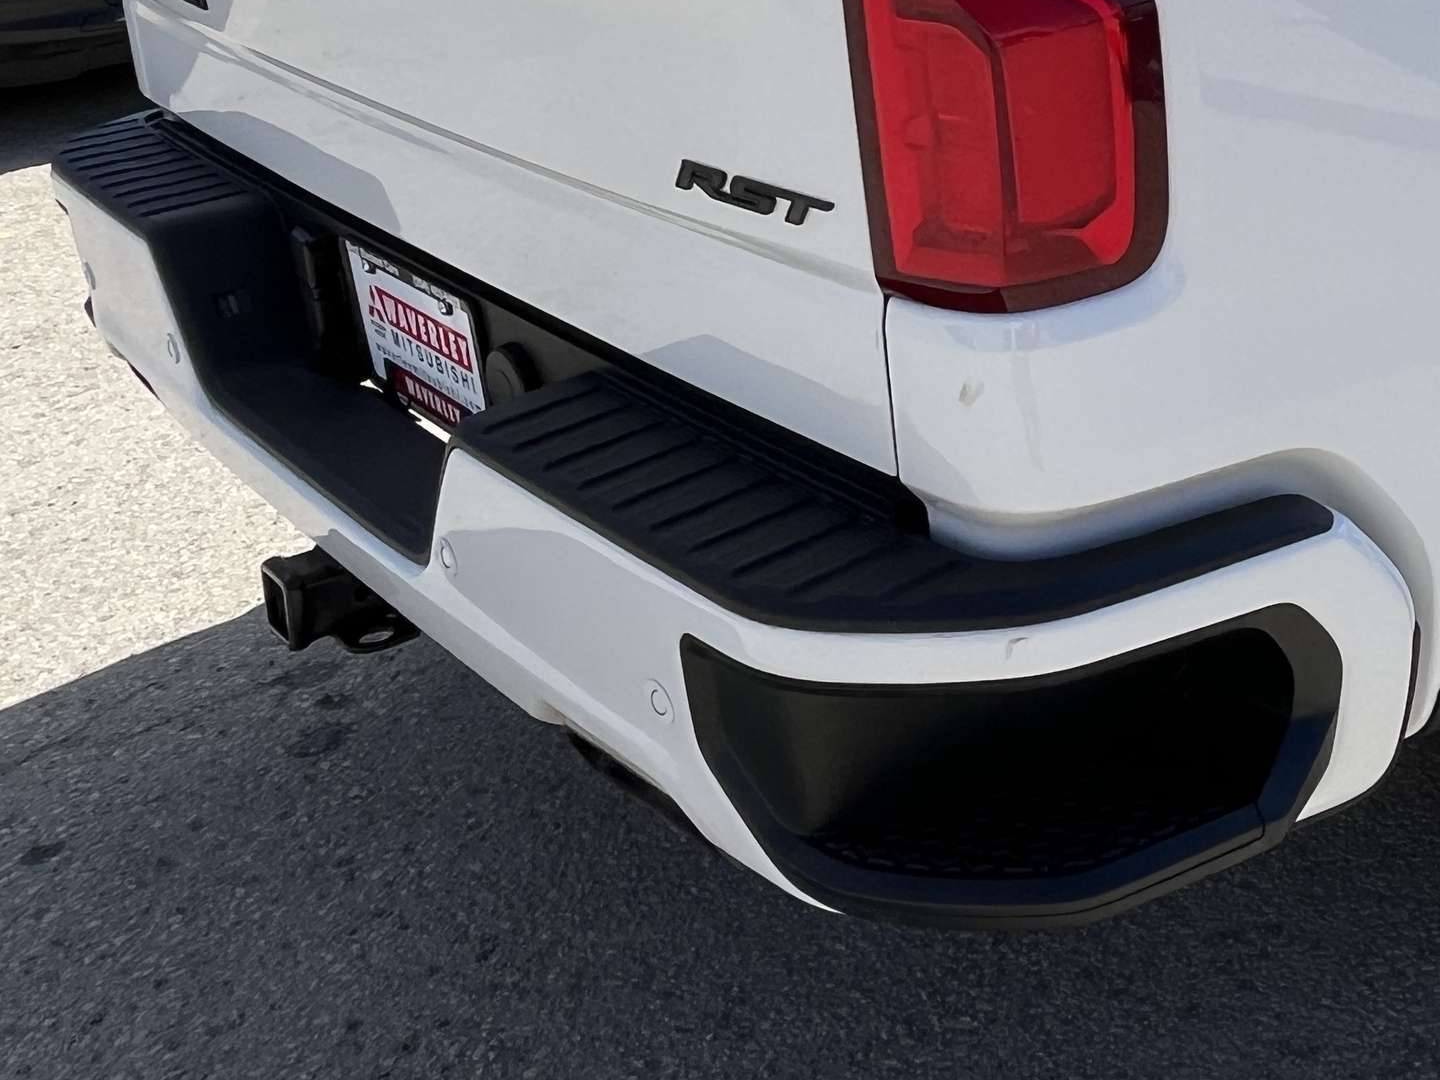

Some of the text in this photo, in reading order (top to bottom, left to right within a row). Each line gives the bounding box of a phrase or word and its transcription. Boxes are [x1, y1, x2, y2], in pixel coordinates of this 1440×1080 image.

[675, 159, 836, 226] RST
[381, 294, 470, 367] WAVERLEY
[390, 329, 478, 395] MITSUBISHI
